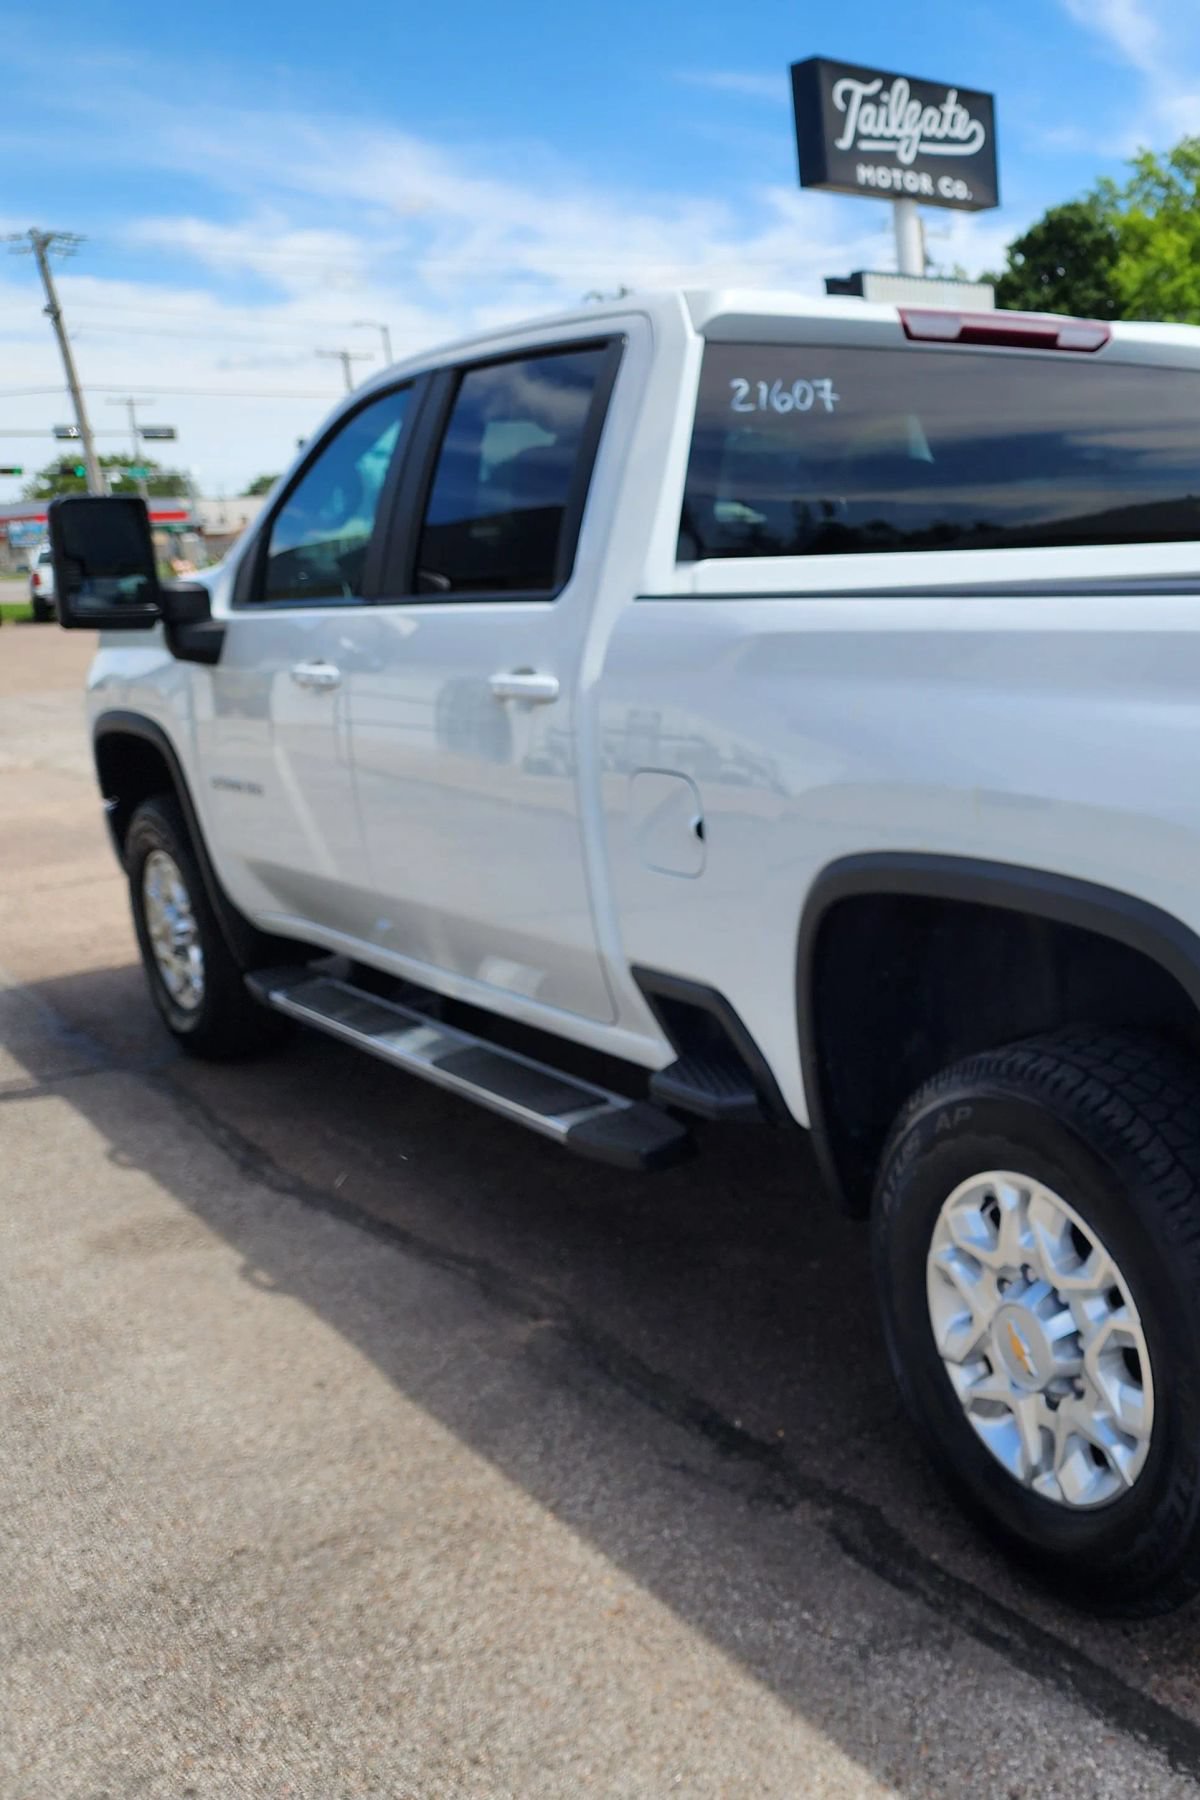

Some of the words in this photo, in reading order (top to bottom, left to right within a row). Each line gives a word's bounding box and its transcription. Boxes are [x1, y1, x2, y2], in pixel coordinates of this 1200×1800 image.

[833, 78, 986, 165] Tailgate
[856, 163, 935, 196] MOTOR
[729, 377, 840, 414] 21607
